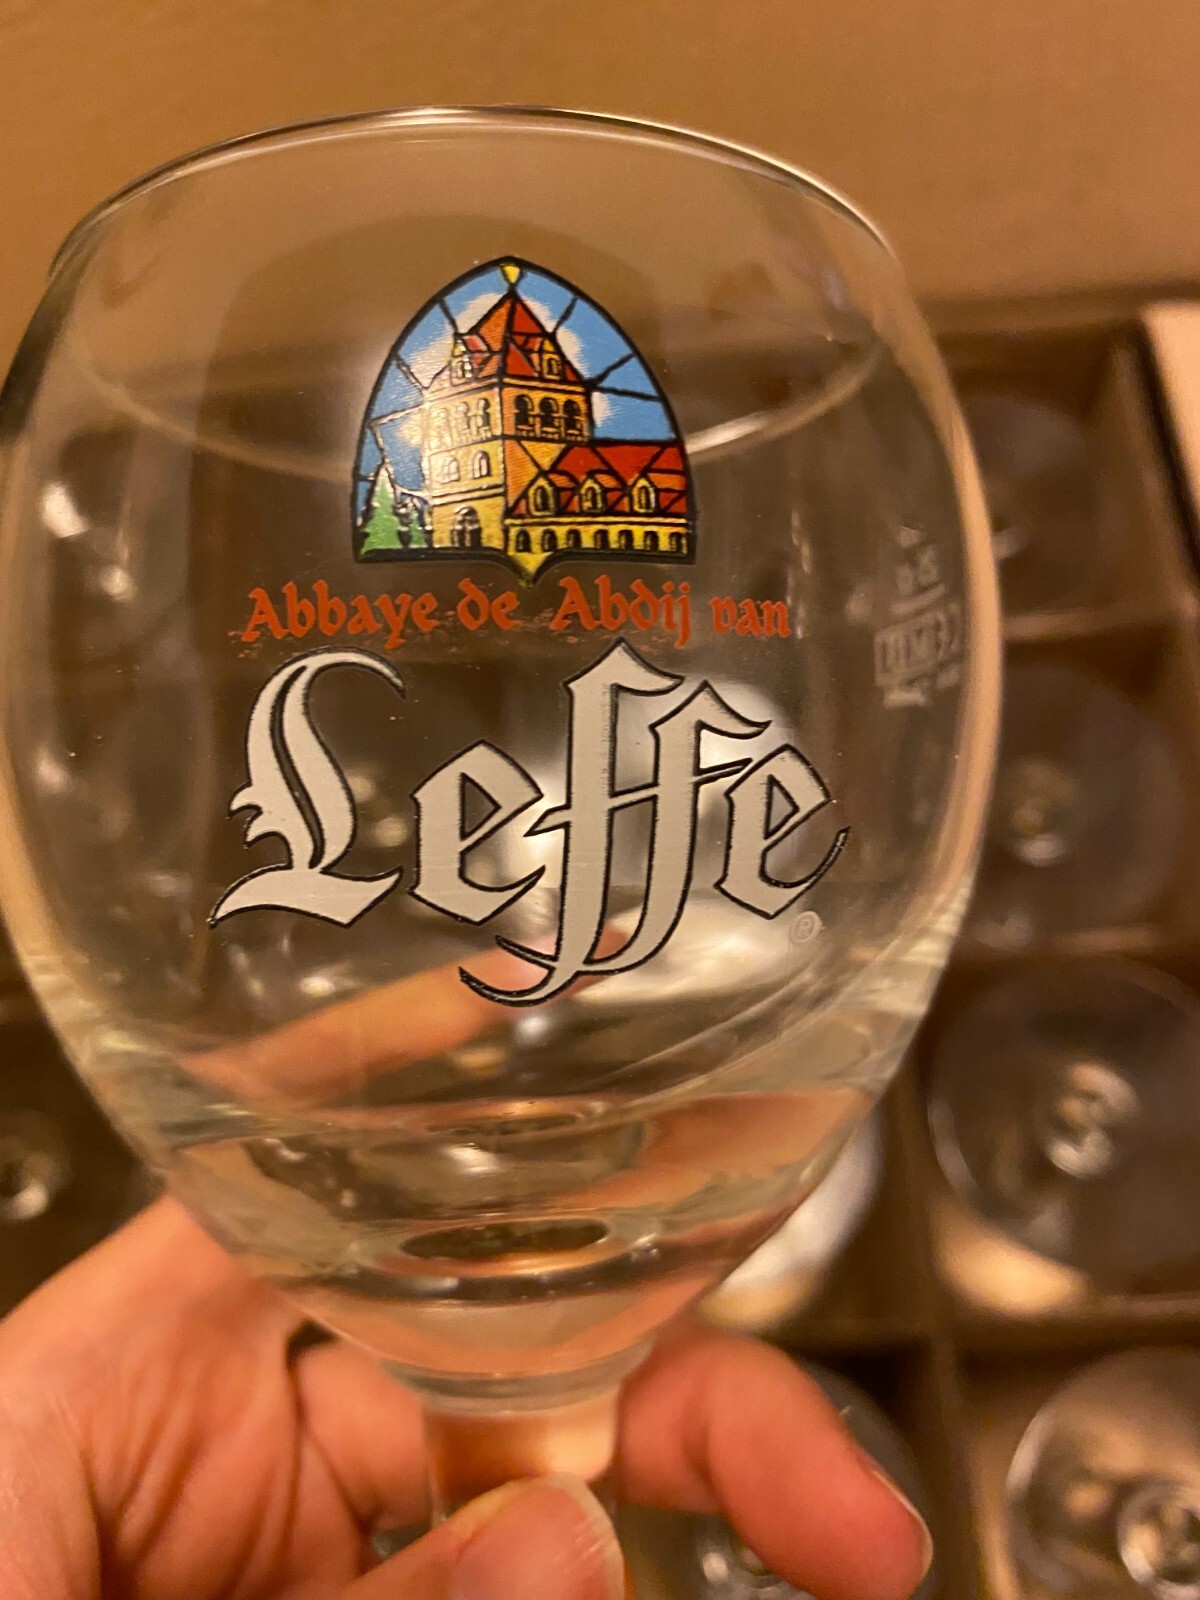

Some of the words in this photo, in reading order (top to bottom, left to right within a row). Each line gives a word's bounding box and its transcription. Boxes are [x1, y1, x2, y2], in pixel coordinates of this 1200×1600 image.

[241, 579, 440, 649] Abbaye
[456, 577, 521, 631] de
[549, 574, 692, 649] Abdij
[709, 596, 791, 638] van
[208, 636, 851, 1008] Leffe
